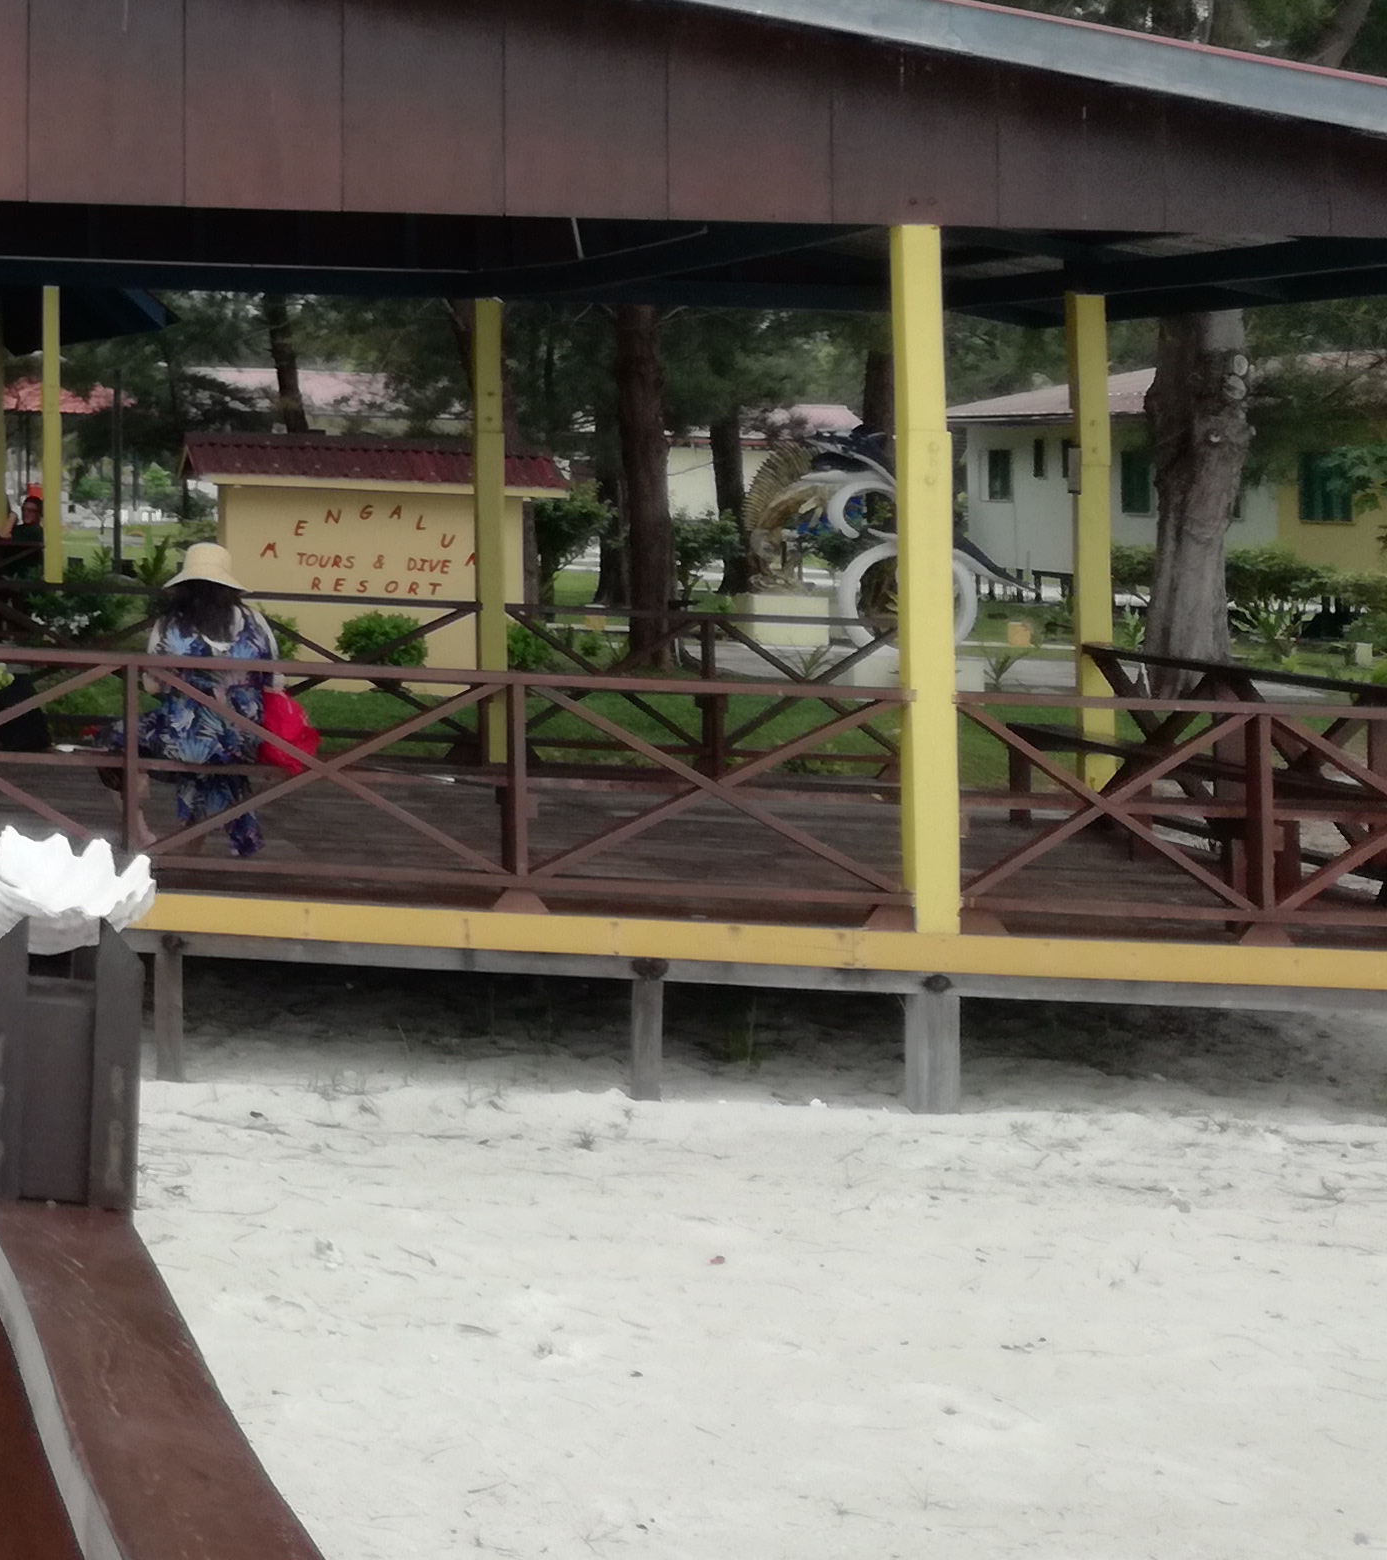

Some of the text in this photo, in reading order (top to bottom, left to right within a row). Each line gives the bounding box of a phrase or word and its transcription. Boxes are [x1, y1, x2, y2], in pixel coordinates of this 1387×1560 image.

[297, 552, 452, 574] TOURS & DIVE
[311, 577, 442, 595] RESORT
